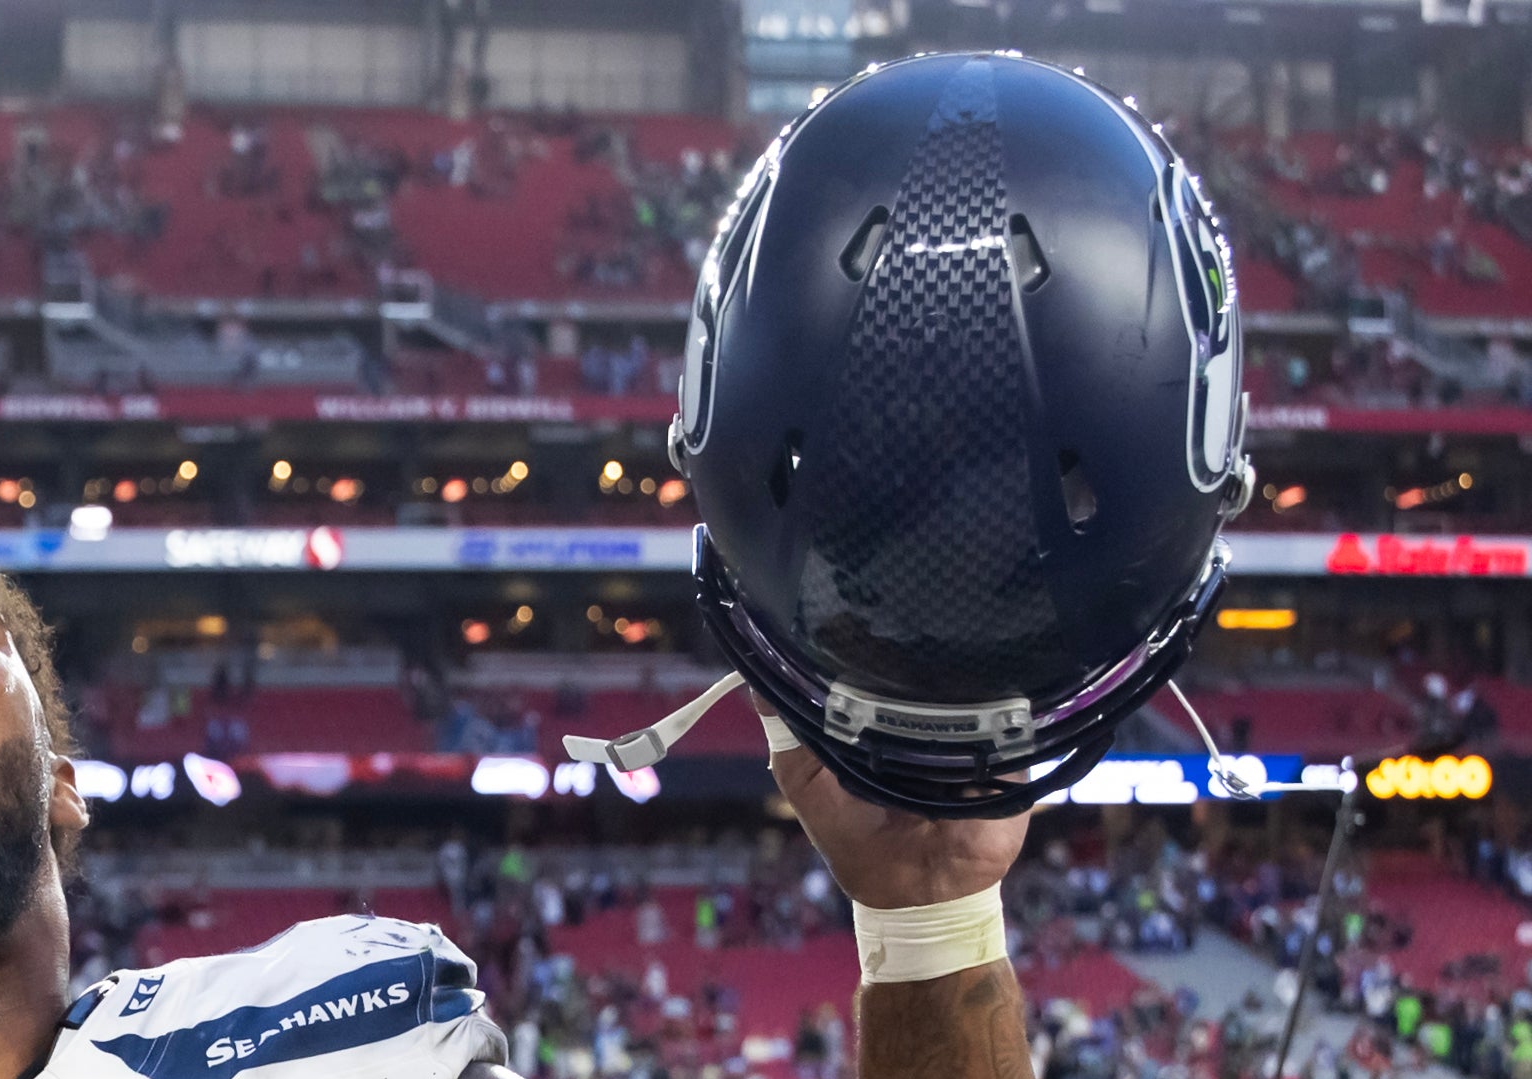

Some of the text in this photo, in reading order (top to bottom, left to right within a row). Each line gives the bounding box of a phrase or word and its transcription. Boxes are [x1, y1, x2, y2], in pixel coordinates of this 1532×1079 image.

[165, 529, 306, 567] SAFEWAY
[876, 714, 978, 733] SEAHAWKS
[205, 982, 410, 1068] SEAHAWKS
